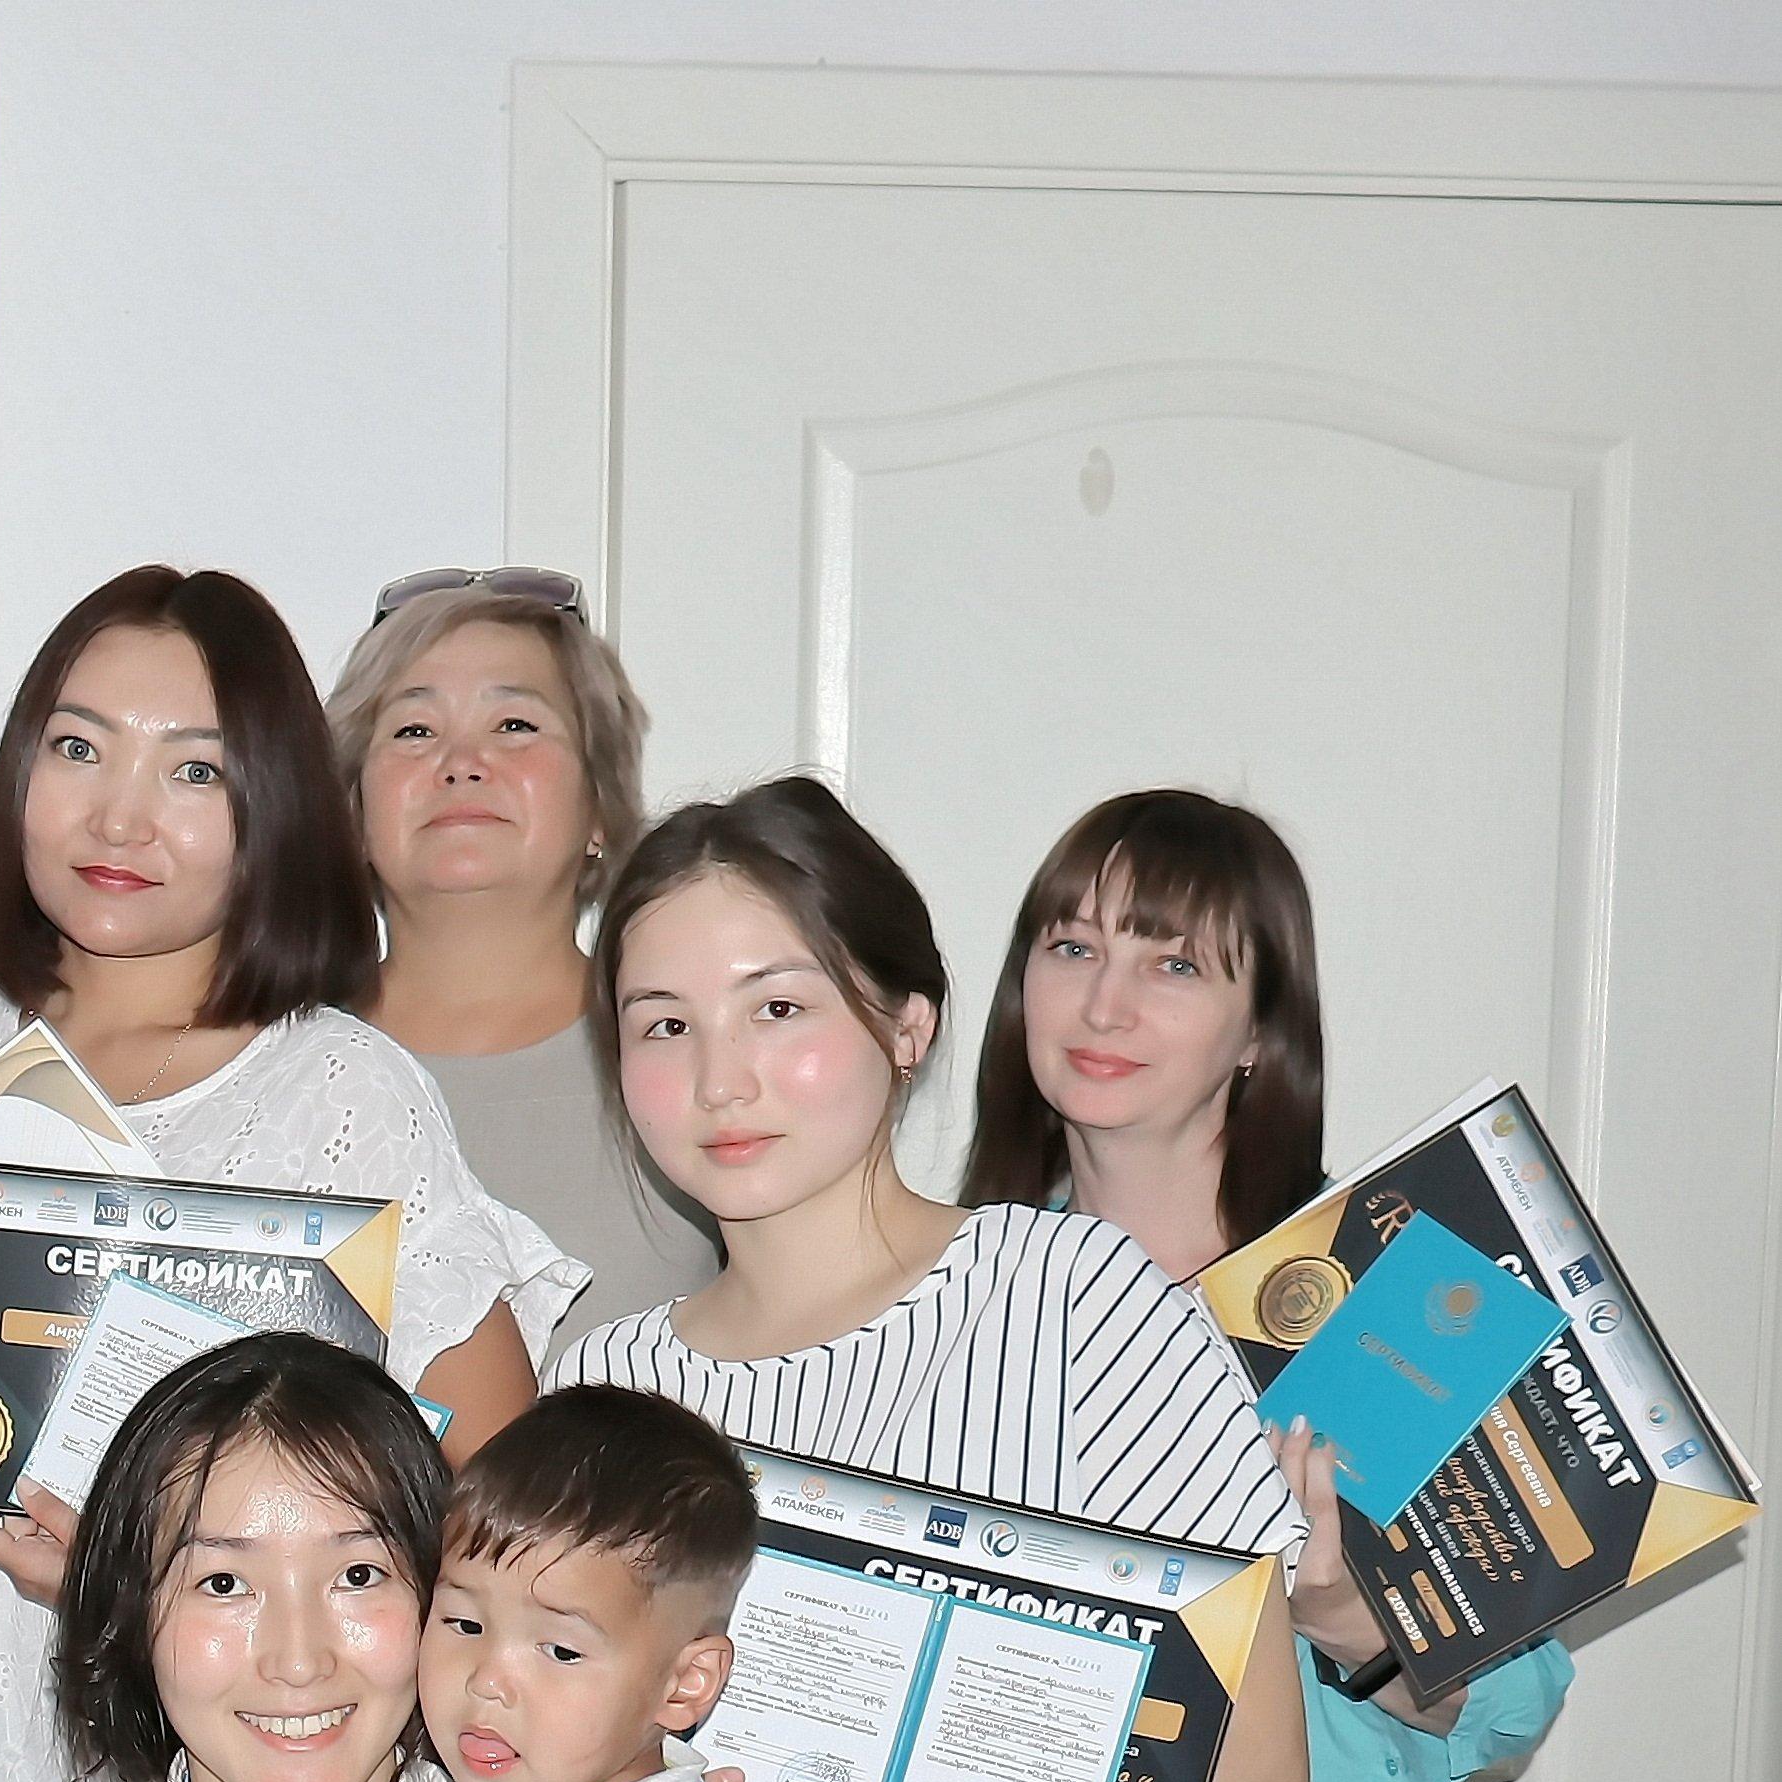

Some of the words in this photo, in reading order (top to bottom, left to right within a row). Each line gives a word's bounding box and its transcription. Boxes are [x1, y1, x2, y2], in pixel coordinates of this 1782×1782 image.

[95, 1206, 127, 1221] ADB
[47, 1245, 313, 1296] СЕРТИФИКАТ
[1566, 1264, 1592, 1294] ADB
[1502, 1430, 1553, 1509] Сергеевна
[771, 1495, 844, 1522] АТАМЕКЕН
[1466, 1436, 1512, 1511] пускником
[1506, 1511, 1536, 1554] курса
[926, 1519, 963, 1541] ADB
